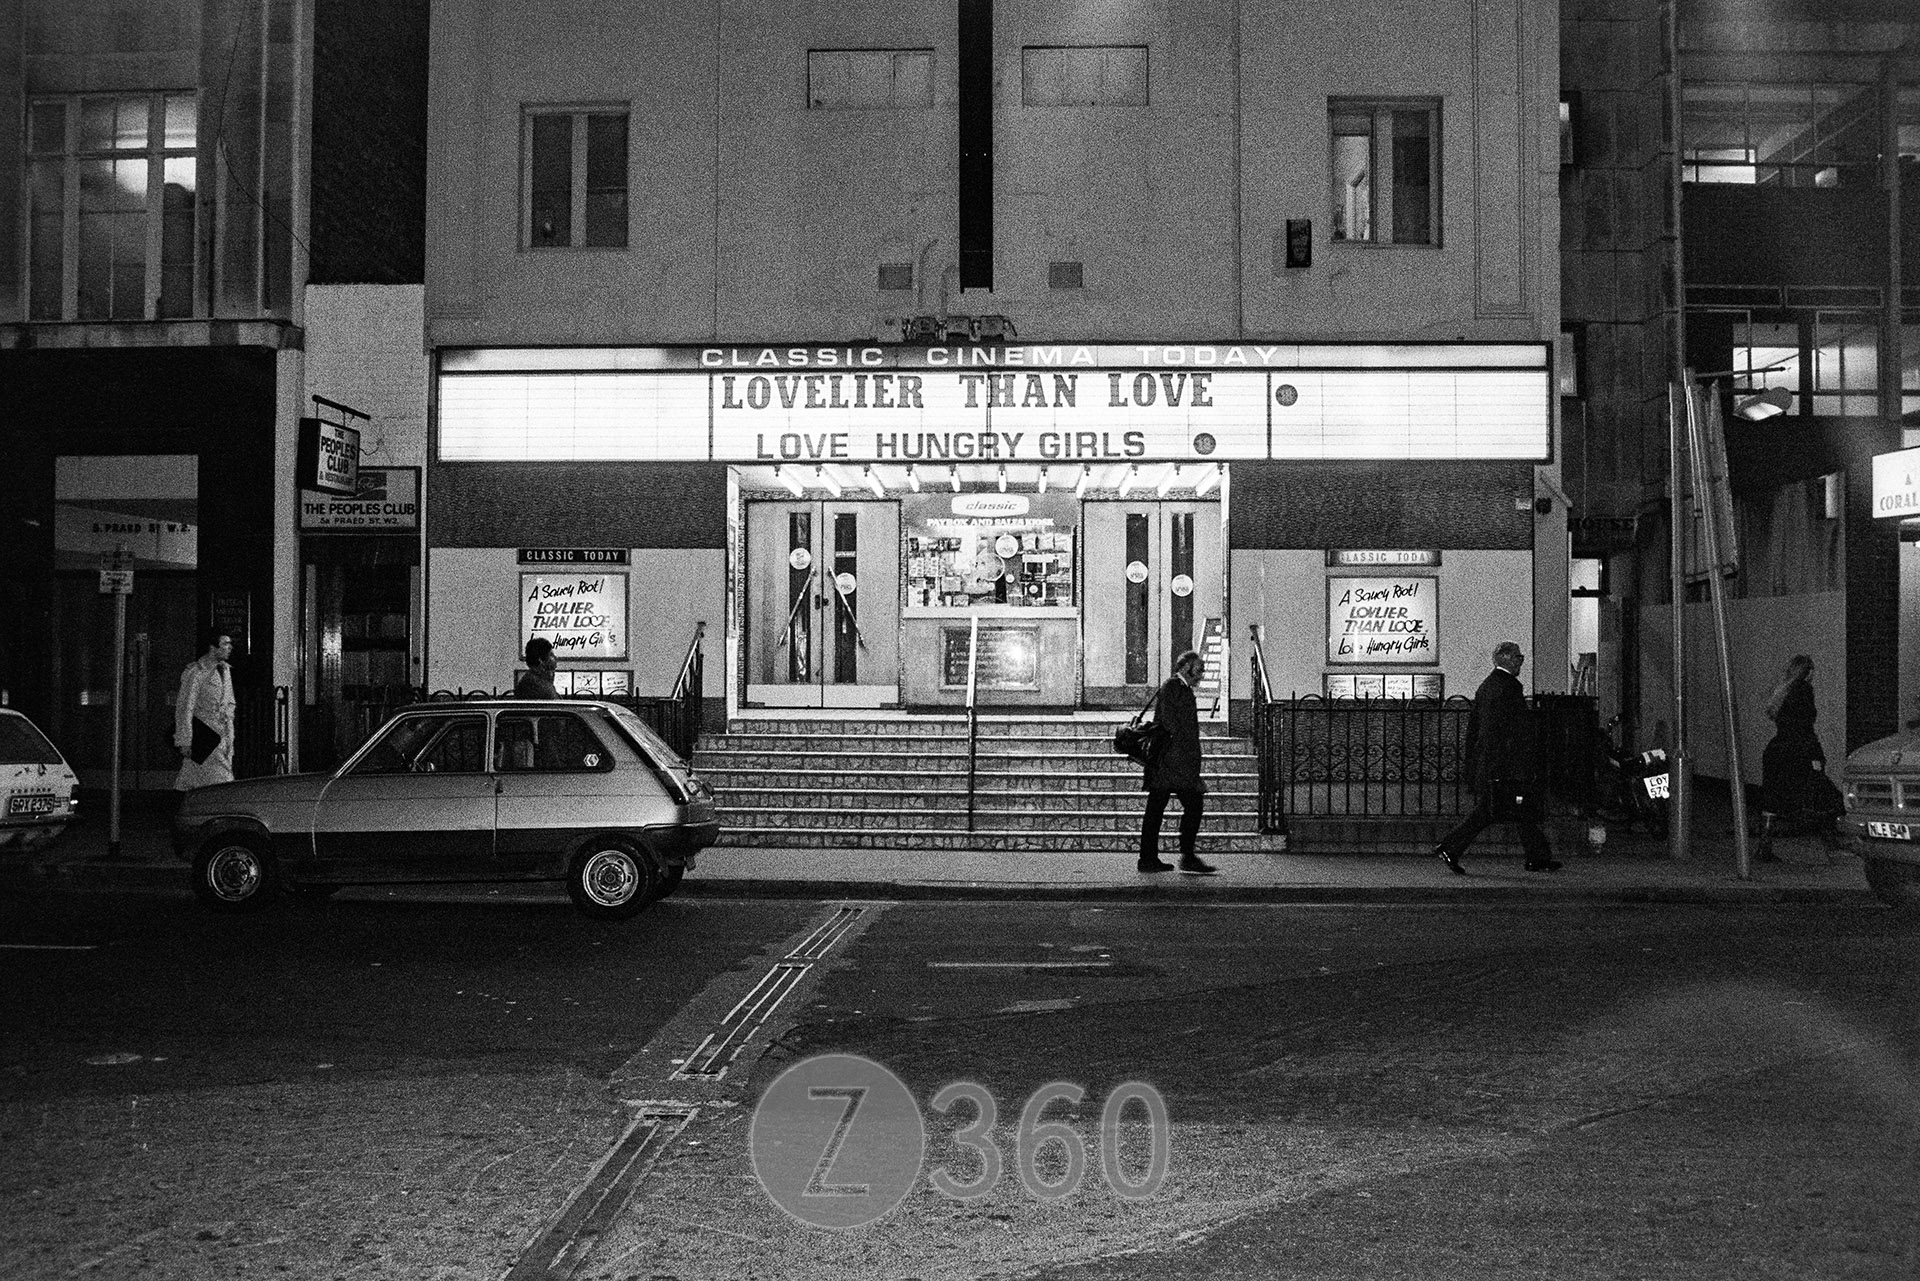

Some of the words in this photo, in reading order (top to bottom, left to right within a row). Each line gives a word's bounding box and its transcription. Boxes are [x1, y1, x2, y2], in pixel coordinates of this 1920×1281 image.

[701, 347, 884, 367] CLASSIC
[926, 346, 1097, 366] CINEMA
[1135, 346, 1279, 366] TODAY
[721, 374, 923, 409] LOVELIER
[959, 374, 1079, 408] THAN
[1108, 373, 1214, 408] LOVE
[320, 435, 356, 460] PEOPLES
[757, 432, 849, 459] LOVE
[876, 432, 1024, 460] HUNGRY
[1038, 431, 1147, 459] GIRLS
[327, 454, 349, 475] CLUB
[304, 503, 326, 515] THE
[329, 503, 381, 515] PEOPLES
[383, 503, 416, 515] CLUB
[965, 500, 1018, 511] classic
[1880, 492, 1919, 511] CORAL
[105, 523, 142, 533] PRAED
[971, 518, 993, 526] AND
[526, 550, 574, 560] CLASSIC
[583, 550, 619, 560] TODAY
[528, 585, 539, 602] A
[542, 584, 575, 599] Saucy
[577, 578, 605, 595] Riot!
[1338, 589, 1350, 607] A
[1355, 588, 1390, 603] Saucy
[1392, 582, 1419, 599] Riot!
[537, 601, 595, 615] LOVLIER
[1349, 606, 1408, 619] LOVLIER
[533, 615, 570, 628] THAN
[1345, 619, 1385, 632] THAN
[552, 632, 587, 650] Hungry
[1366, 637, 1403, 655] Hungry
